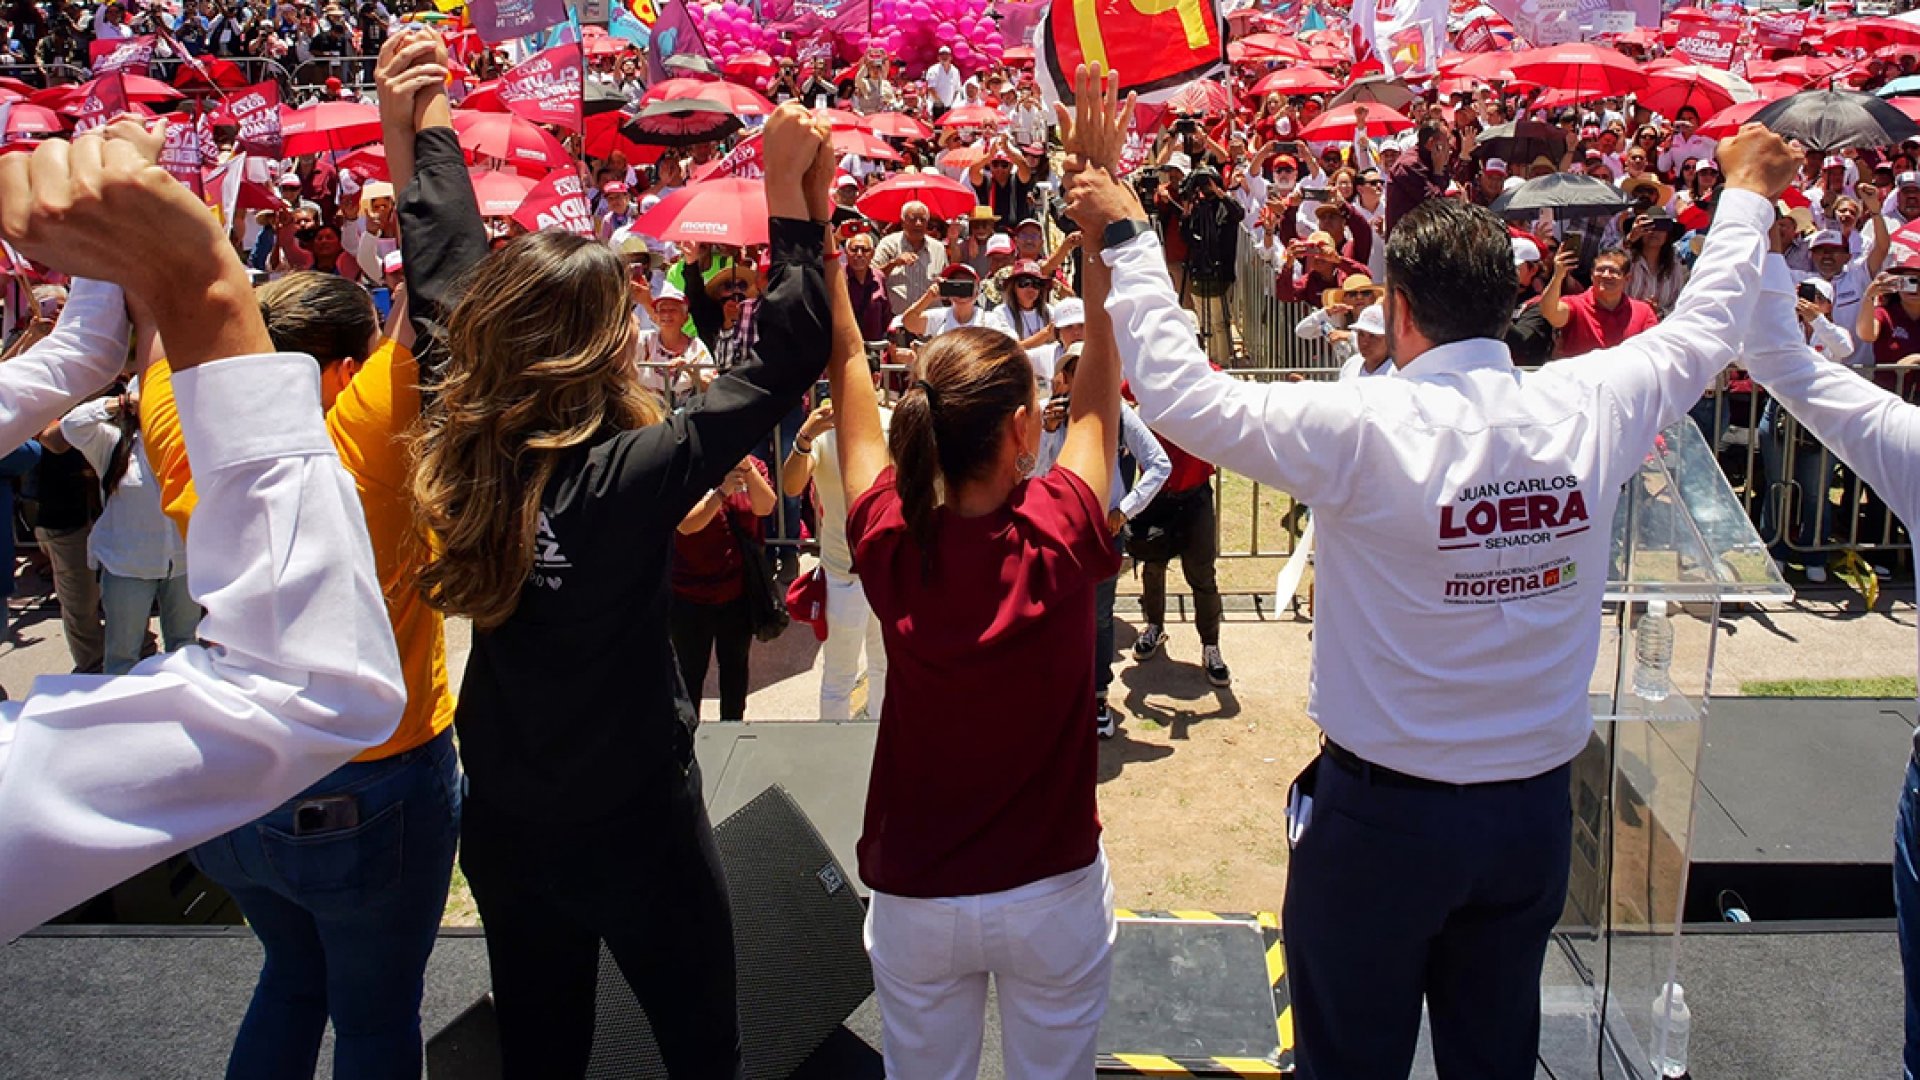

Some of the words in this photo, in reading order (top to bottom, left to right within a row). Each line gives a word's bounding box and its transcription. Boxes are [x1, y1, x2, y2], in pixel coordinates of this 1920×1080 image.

[680, 221, 728, 232] morena
[1459, 482, 1500, 502] JUAN
[1503, 475, 1578, 495] CARLOS
[1439, 490, 1589, 539] LOERA
[1485, 532, 1551, 549] SENADOR
[1444, 573, 1541, 597] morena
